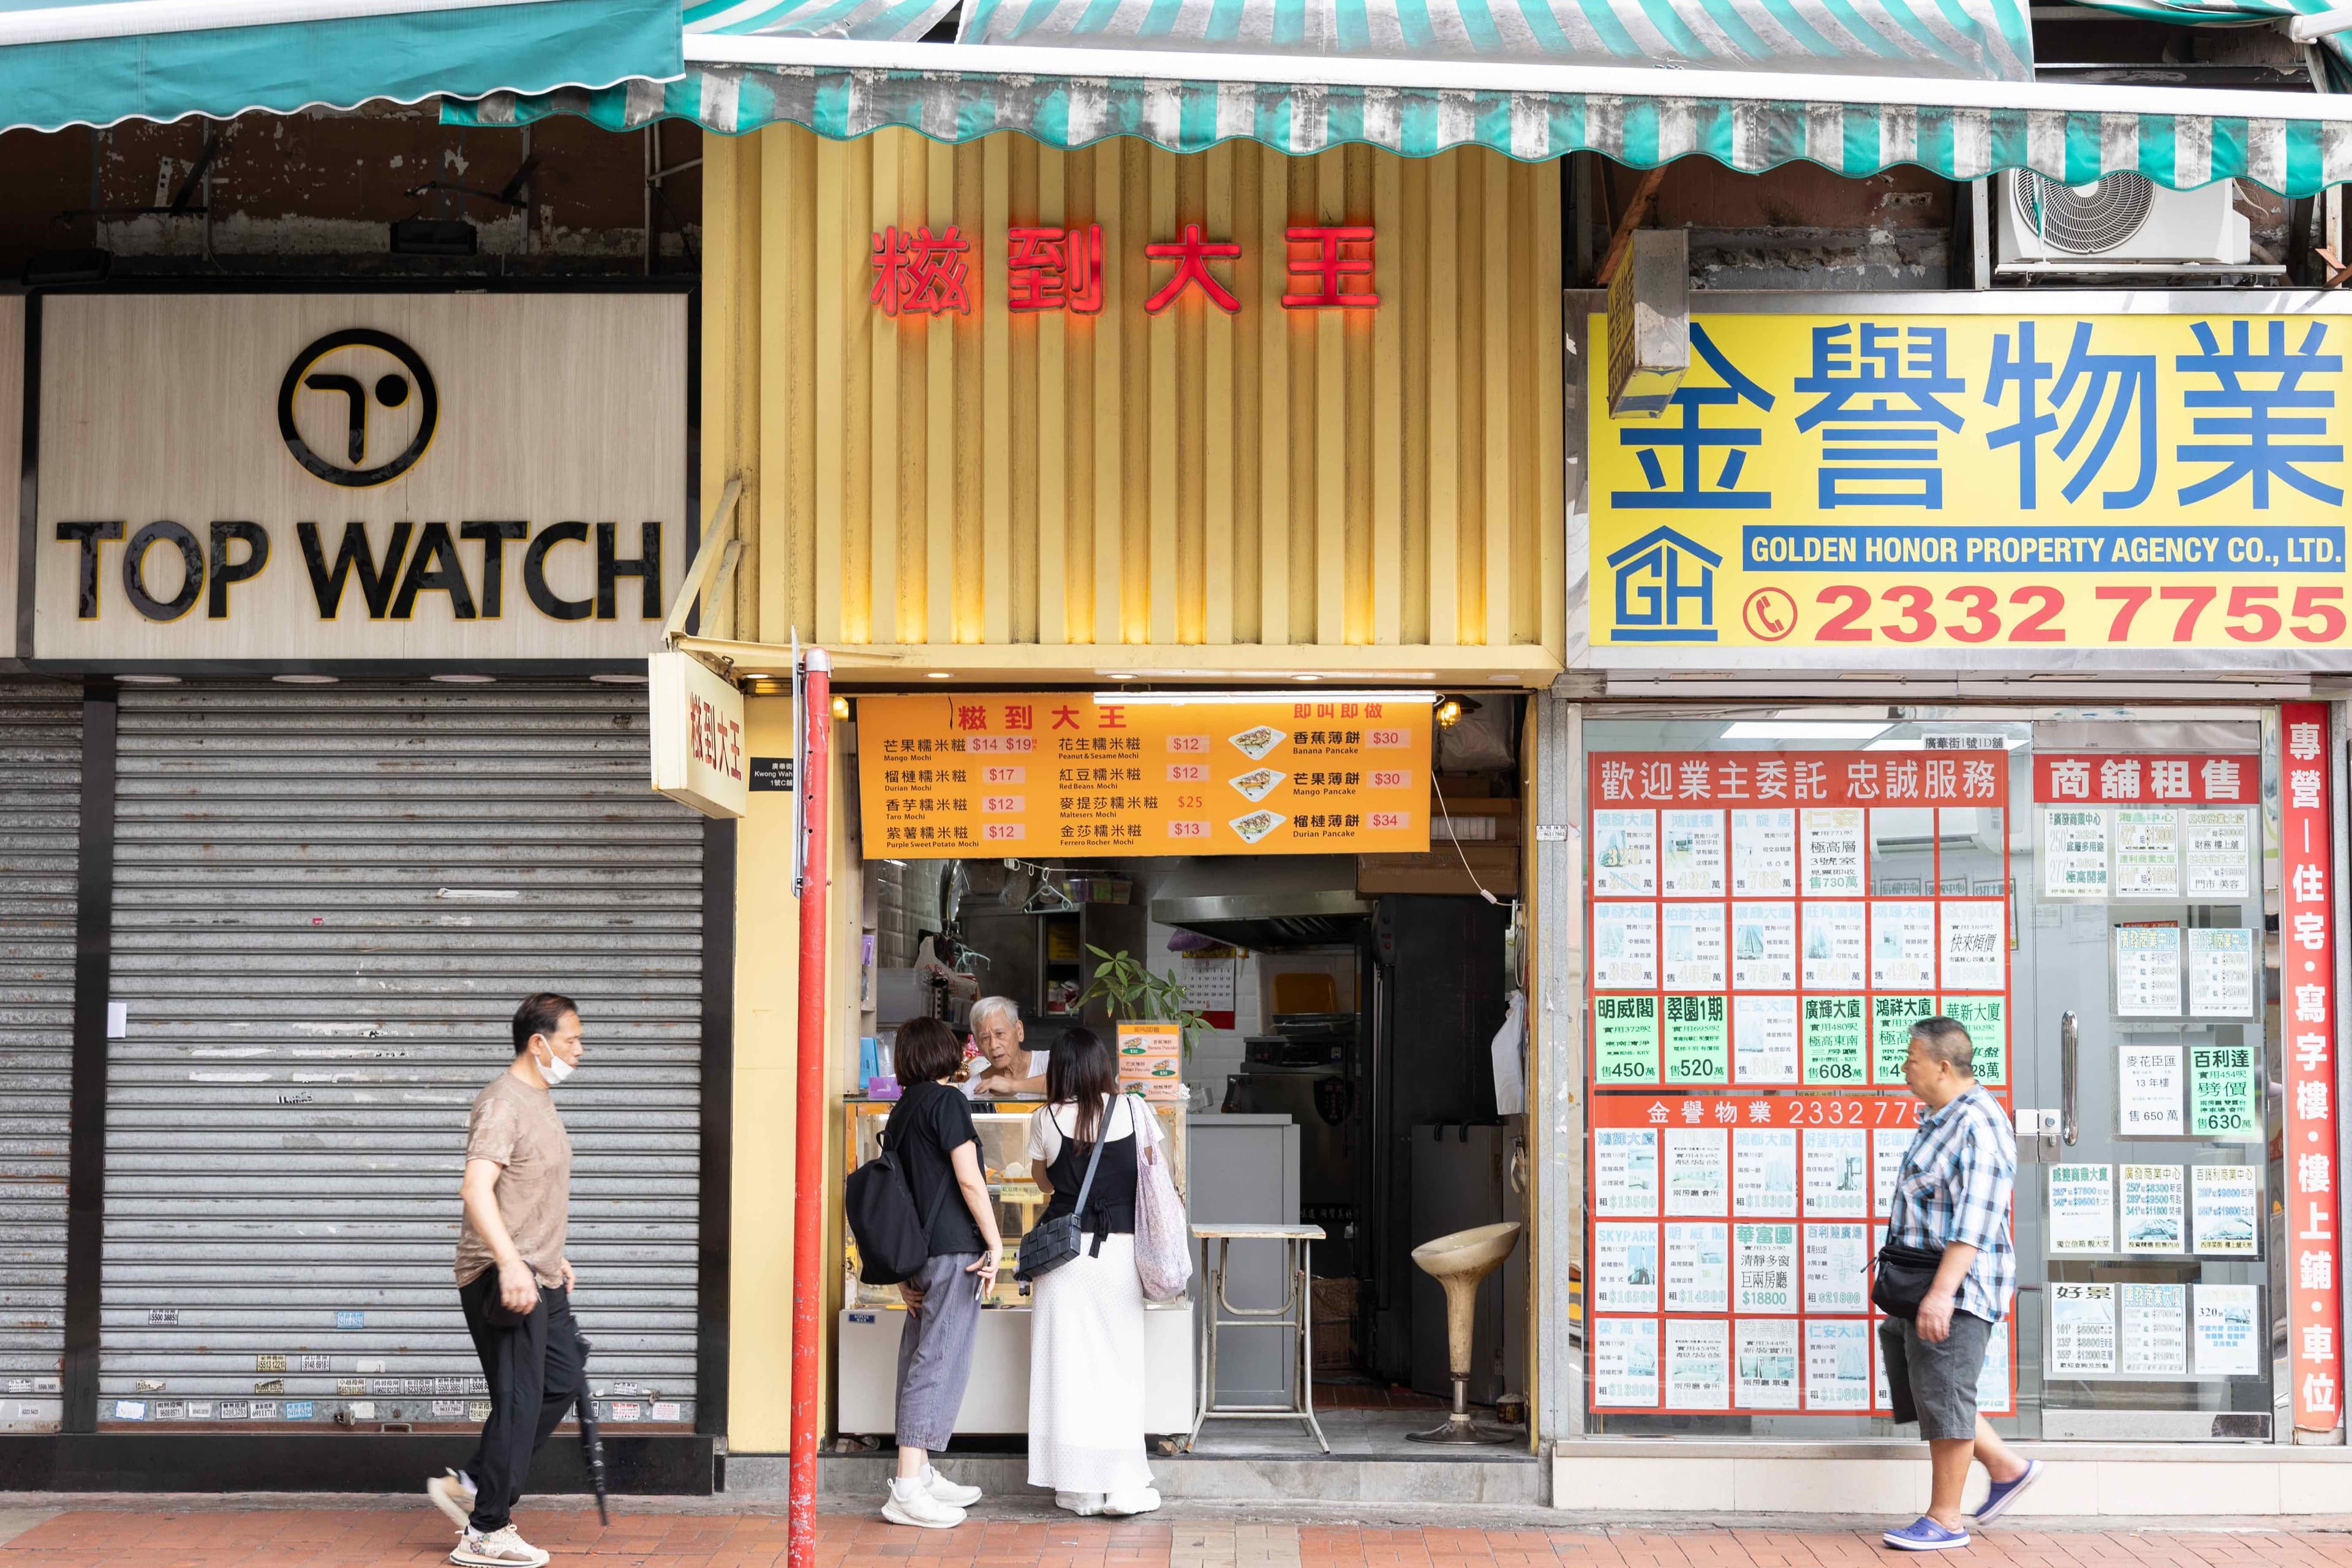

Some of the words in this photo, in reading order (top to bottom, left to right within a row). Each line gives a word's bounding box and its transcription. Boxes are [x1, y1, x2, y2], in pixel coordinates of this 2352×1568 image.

[870, 224, 1381, 316] 糍到大王
[1607, 320, 2345, 511] 金譽物業
[1752, 537, 1856, 562] GOLDEN
[1866, 537, 1958, 562] HONOR
[1967, 537, 2101, 562] PROPERTY
[2111, 537, 2217, 562] AGENCY
[2227, 537, 2280, 567] CO.,
[2288, 537, 2342, 562] LTD.
[56, 521, 273, 622] TOP
[297, 521, 665, 622] WATCH
[1814, 585, 2067, 642] 2332
[2095, 586, 2347, 642] 7755
[958, 705, 1126, 730] 糍到大王
[1294, 703, 1382, 719] 即叫即做
[690, 691, 741, 781] 糍到大王
[1294, 731, 1360, 745] 香蕉薄餅
[1373, 733, 1398, 744] $30
[884, 739, 965, 752] 芒果糯米糍
[973, 738, 998, 751] $14
[1006, 738, 1031, 751] $19
[1059, 737, 1140, 750] 花生糯米糍
[1174, 738, 1199, 750] $12
[1925, 737, 2003, 749] 廣華街1號1D舖
[885, 770, 967, 783] 榴槤糯米糍
[989, 768, 1014, 781] $17
[1059, 768, 1140, 781] 紅豆糯米糍
[1173, 767, 1198, 778] $12
[1294, 772, 1360, 785] 芒果薄餅
[2050, 759, 2241, 799] 商舖租售
[1375, 774, 1400, 785] $30
[1600, 760, 1828, 801] 歡迎業主委託
[1847, 760, 1996, 797] 忠誠服務
[886, 799, 967, 811] 香芋糯米糍
[989, 799, 1014, 811] $12
[1060, 797, 1158, 809] 麥提莎糯米糍
[1178, 796, 1202, 809] $25
[1294, 814, 1360, 827] 榴槤薄餅
[1373, 815, 1398, 826] $34
[887, 826, 968, 839] 紫薯糯米糍
[989, 826, 1014, 838] $12
[1060, 824, 1142, 837] 金莎糯米糍
[1175, 823, 1199, 835] $13
[1811, 841, 1856, 853] 極高層
[2195, 840, 2211, 850] 財務
[1809, 876, 1858, 889] 售730萬
[2195, 880, 2215, 889] 門市
[2220, 880, 2239, 889] 美容
[1951, 933, 1996, 952] 快來傾價
[1598, 998, 1654, 1019] 明威閣
[1667, 996, 1723, 1022] 翠園1期
[1806, 999, 1861, 1019] 廣輝大廈
[1877, 998, 1931, 1017] 鴻祥大廈
[1946, 1003, 2000, 1021] 華新大廈
[1808, 1035, 1858, 1047] 極高東南
[2127, 1055, 2176, 1068] 麥花臣匯
[2193, 1050, 2250, 1068] 百利達
[1602, 1062, 1656, 1077] 售450萬
[1670, 1059, 1724, 1077] 售520萬
[1808, 1064, 1863, 1079] 售608萬
[2198, 1071, 2247, 1079] 實用454呎
[2149, 1078, 2169, 1088] 年樓
[2198, 1082, 2247, 1097] 劈價
[1647, 1101, 1771, 1123] 金譽物業
[1789, 1101, 1863, 1124] 2332
[1875, 1101, 1926, 1125] 775
[2129, 1110, 2139, 1121] 售
[2144, 1112, 2163, 1121] 650
[2167, 1110, 2178, 1121] 萬
[2198, 1115, 2252, 1129] 售630萬
[2125, 1167, 2181, 1180] 廣發商業中心
[1598, 1230, 1656, 1242] SKYPARK
[1736, 1226, 1792, 1244] 華富園
[1741, 1271, 1787, 1288] 巨兩房廳
[1742, 1291, 1787, 1305] $18800
[1819, 1291, 1860, 1303] $21800
[2056, 1286, 2112, 1300] 好景
